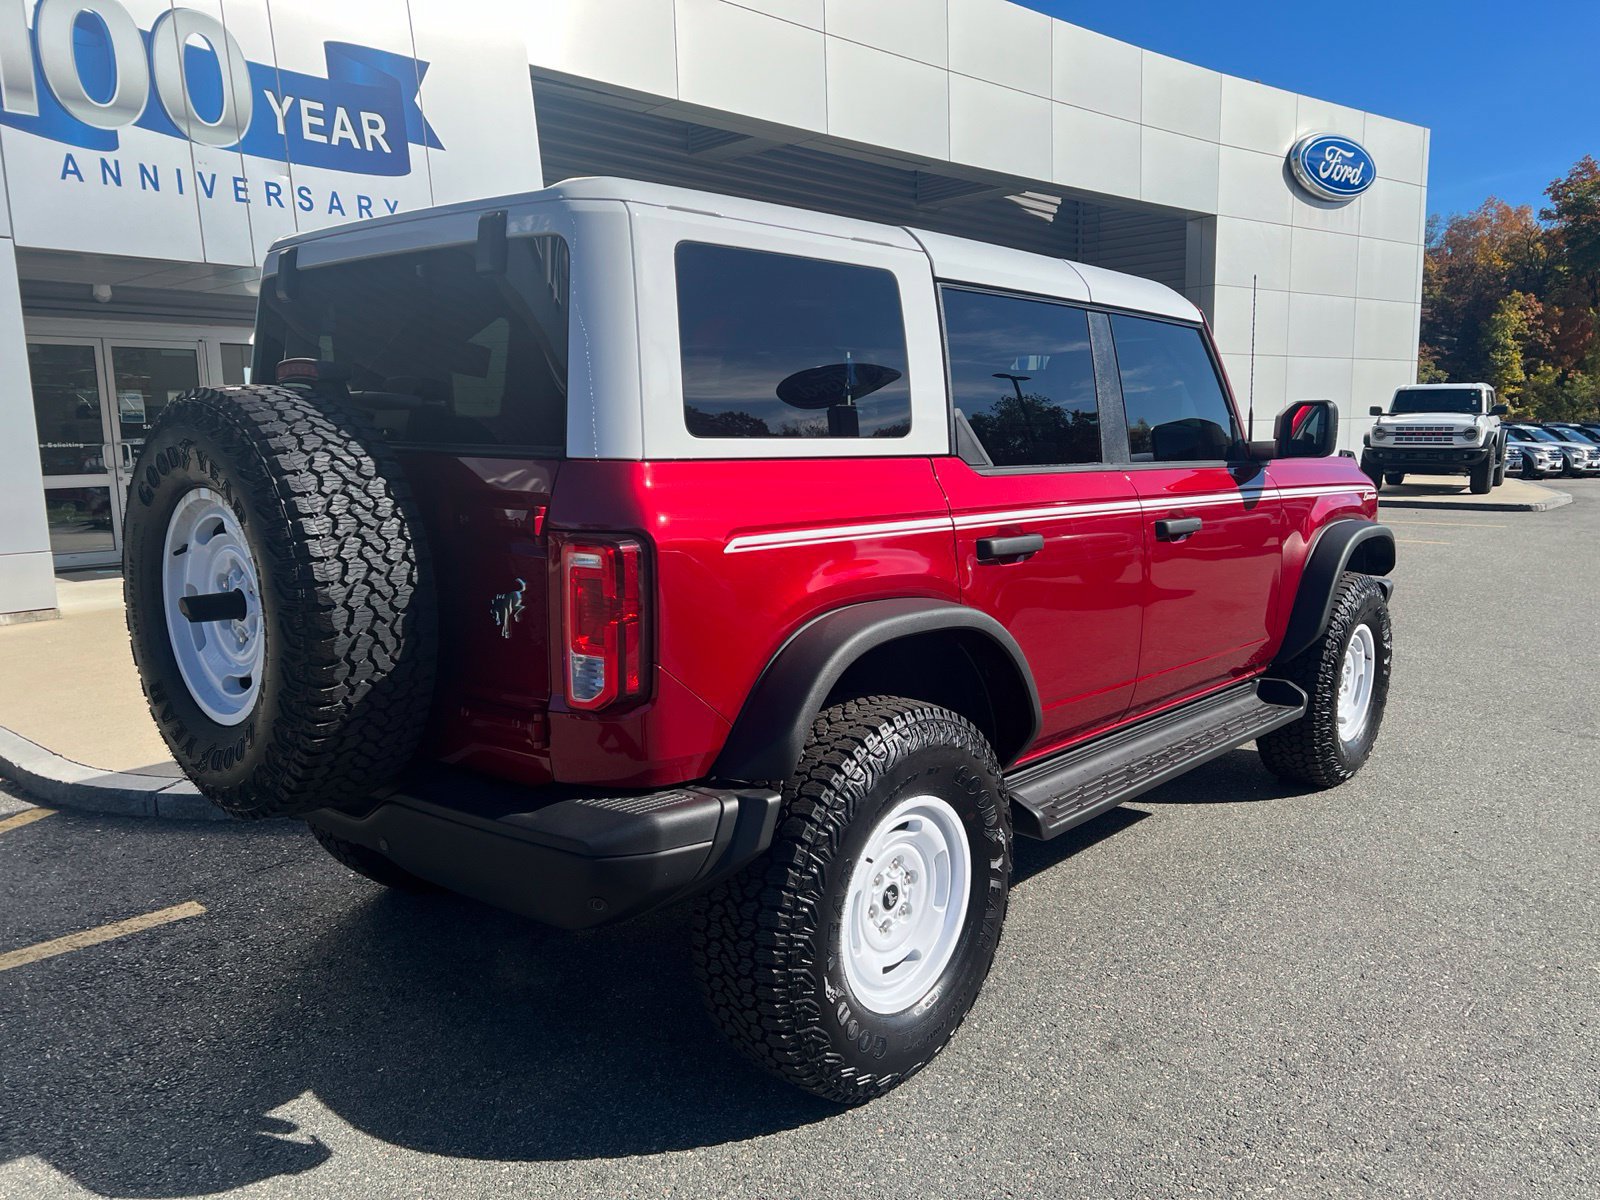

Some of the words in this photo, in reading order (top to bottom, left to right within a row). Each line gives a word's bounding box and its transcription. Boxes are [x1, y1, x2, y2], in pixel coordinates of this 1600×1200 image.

[264, 90, 392, 153] YEAR
[60, 153, 399, 218] ANNIVERSARY
[1319, 146, 1365, 185] Ford
[138, 439, 247, 526] GOODYEAR
[953, 765, 1007, 951] GOODYEAR
